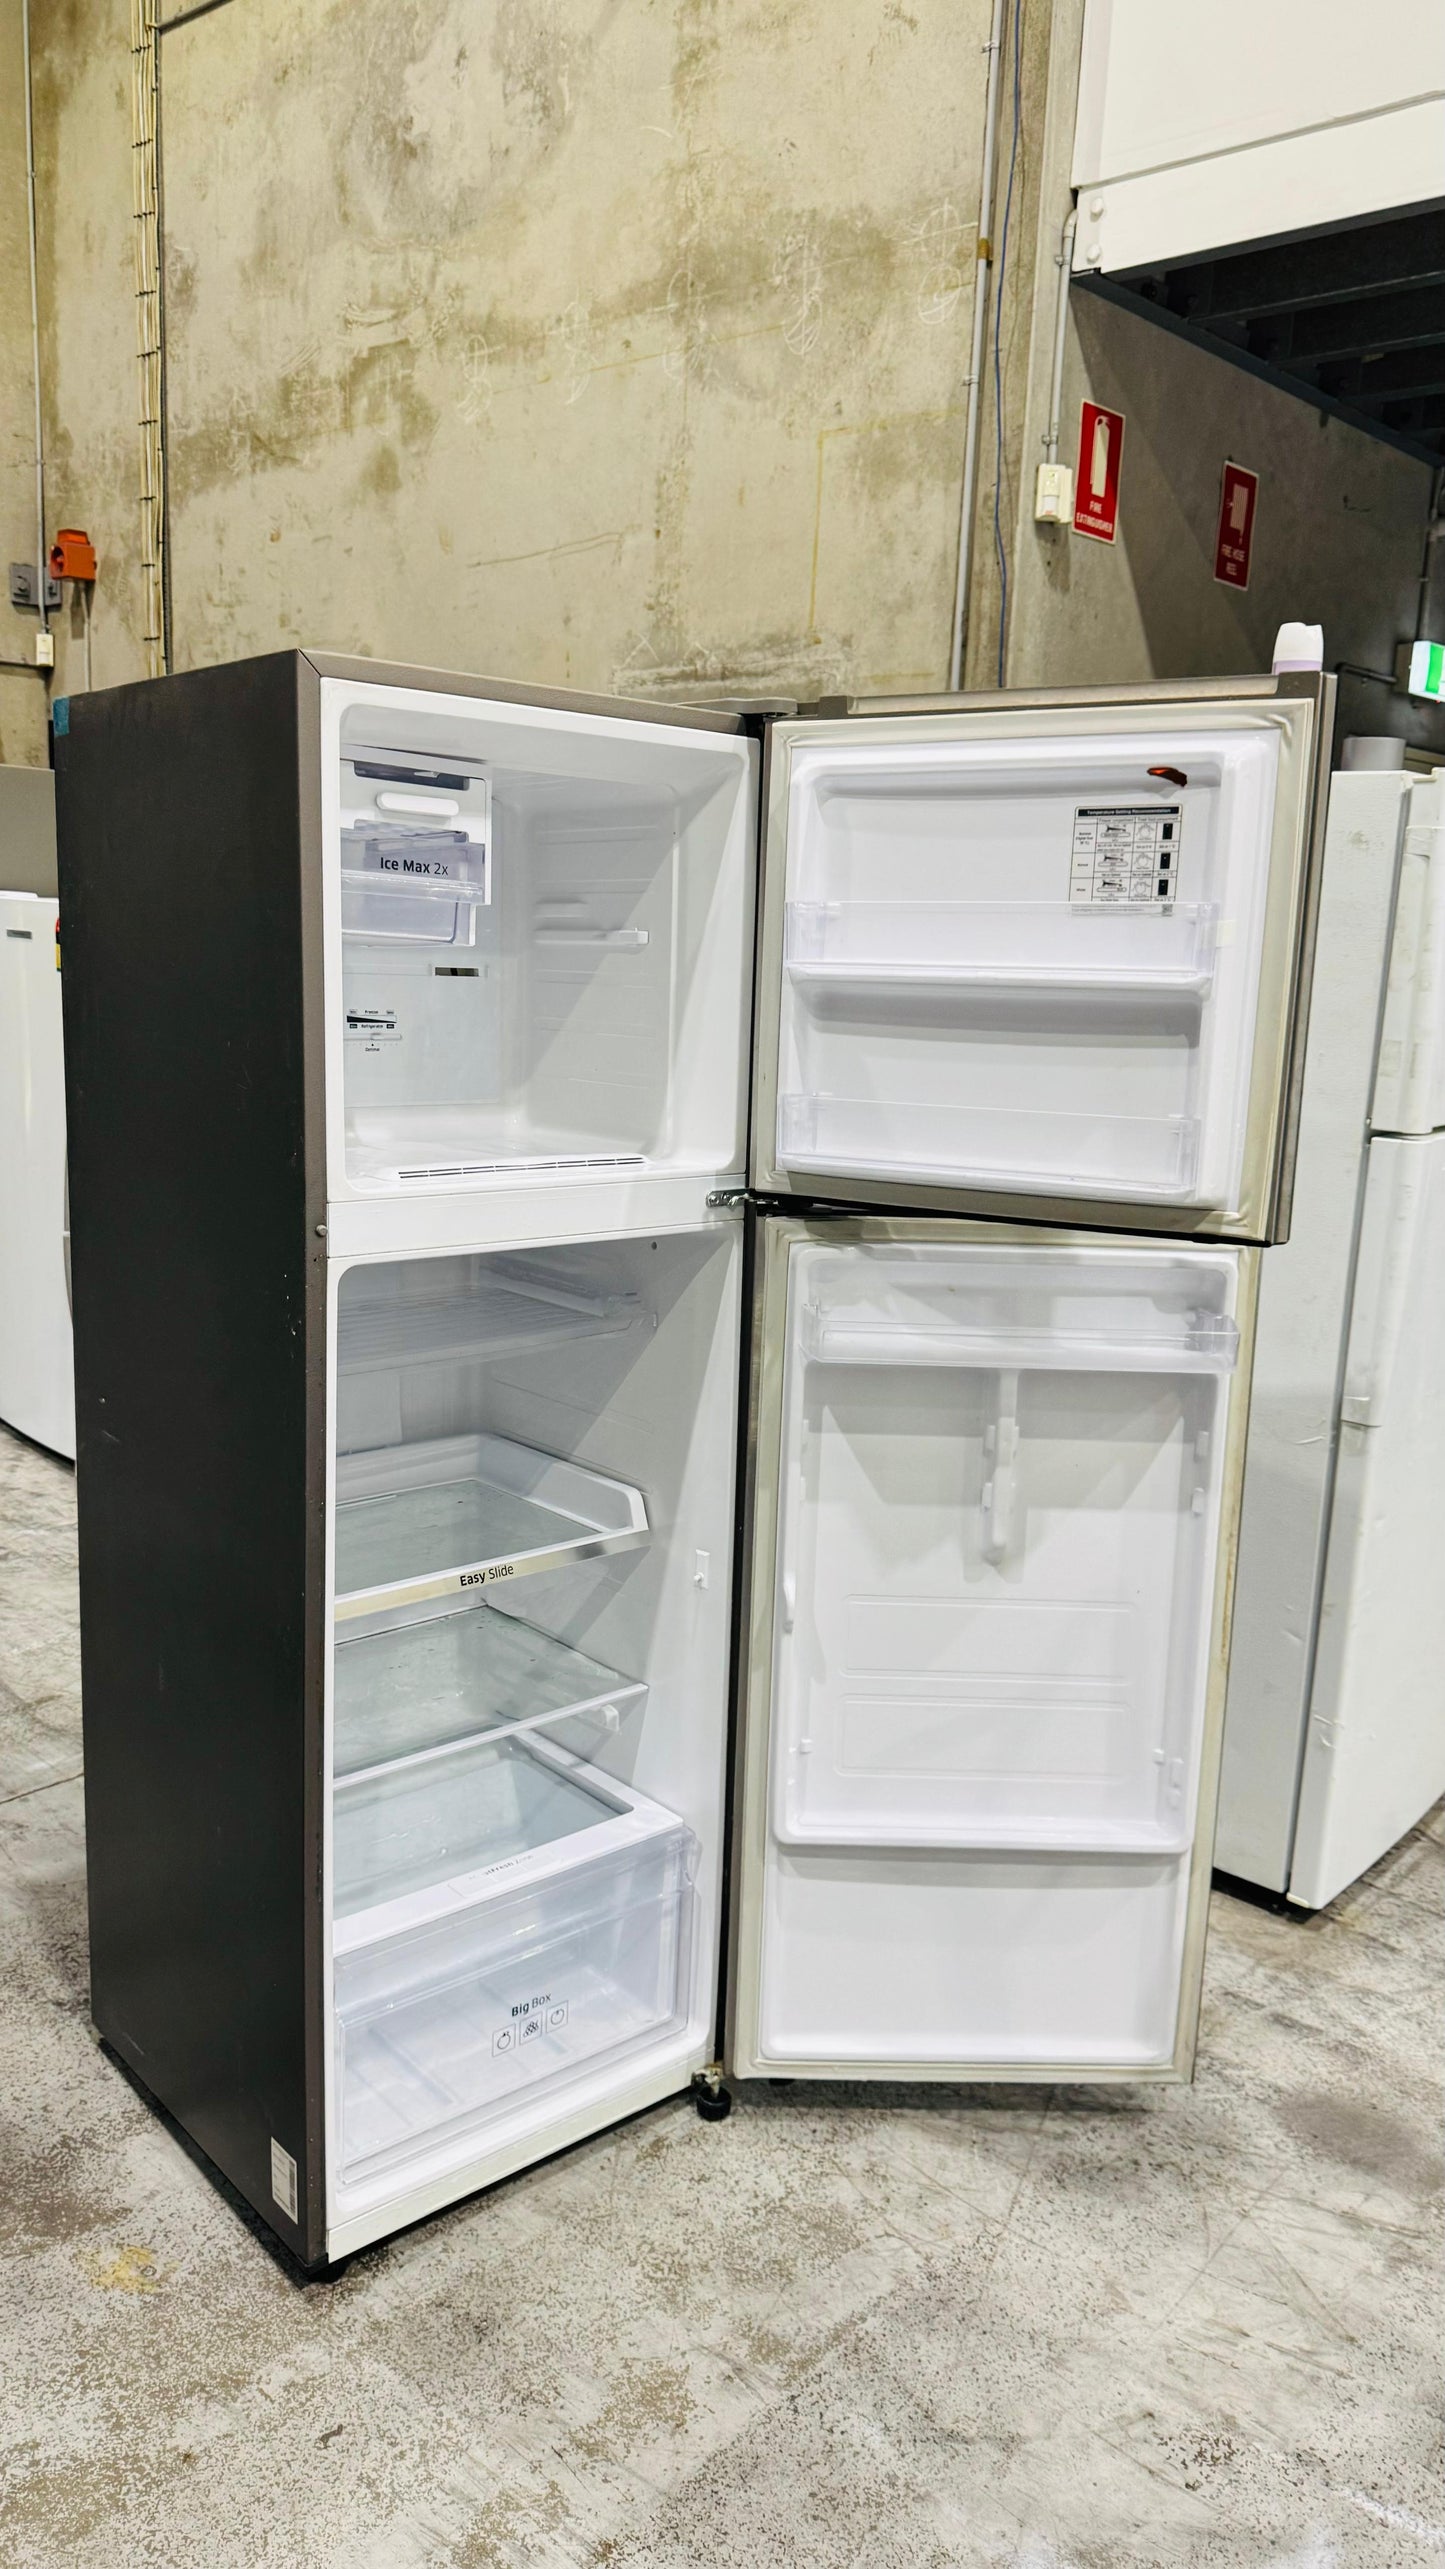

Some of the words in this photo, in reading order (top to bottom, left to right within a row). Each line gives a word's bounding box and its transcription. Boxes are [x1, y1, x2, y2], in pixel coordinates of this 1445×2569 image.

[1089, 500, 1102, 514] FIRE
[1076, 511, 1113, 533] EXTINGUISHER
[380, 856, 399, 871] Ice
[403, 859, 430, 874] Max
[434, 862, 448, 876] 2x
[460, 1572, 486, 1587] Easy
[489, 1565, 514, 1580] Slide
[511, 2003, 530, 2017] Big
[531, 1993, 551, 2009] Box
